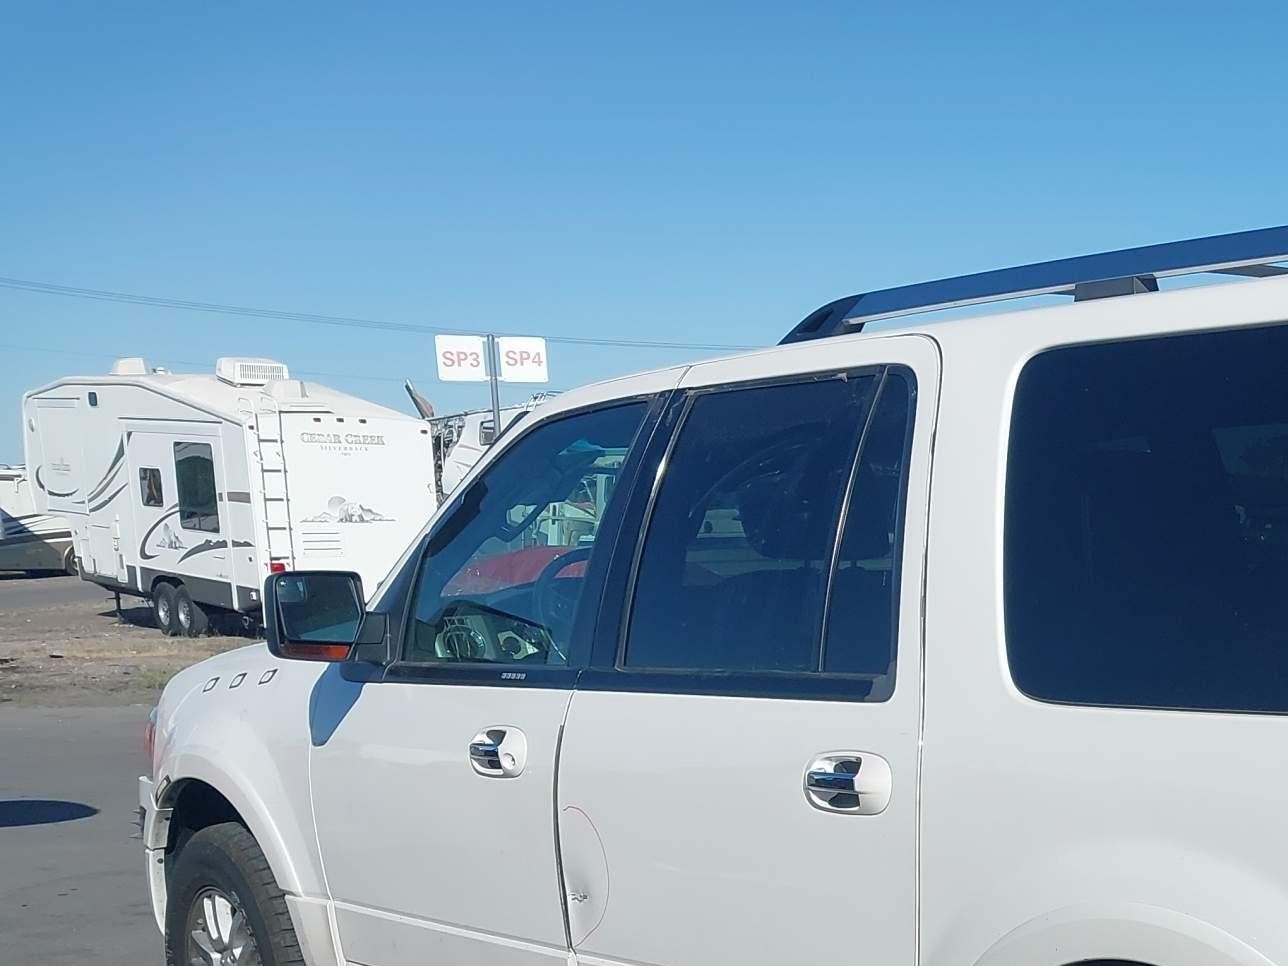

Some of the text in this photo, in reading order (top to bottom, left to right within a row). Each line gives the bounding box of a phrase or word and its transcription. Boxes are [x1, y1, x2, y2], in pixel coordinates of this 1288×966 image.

[441, 350, 481, 368] SP3
[504, 350, 544, 367] SP4
[344, 433, 384, 445] CREEK
